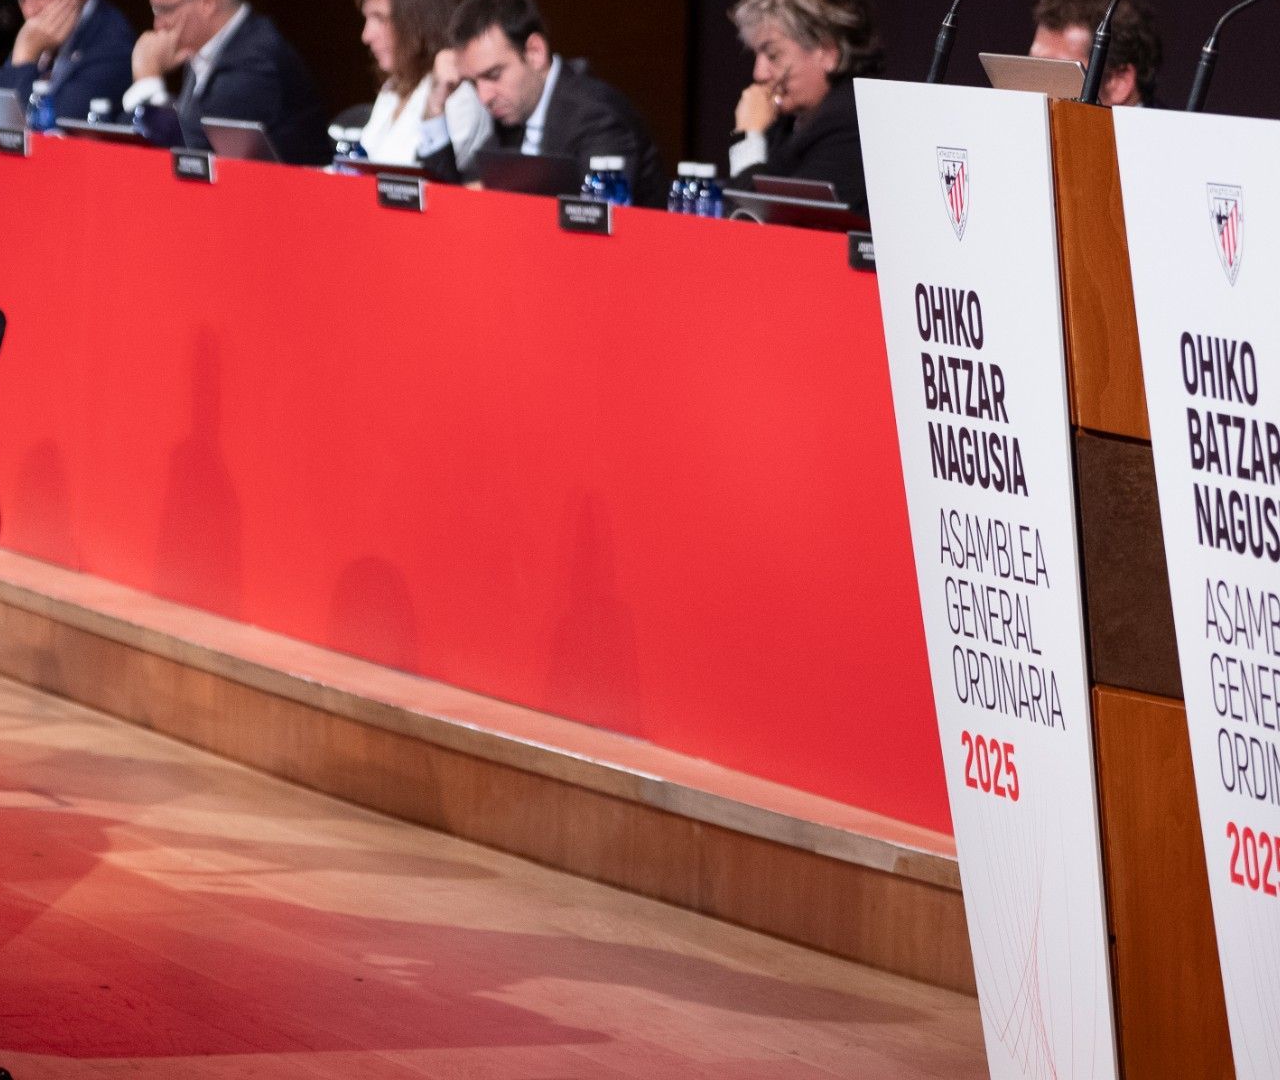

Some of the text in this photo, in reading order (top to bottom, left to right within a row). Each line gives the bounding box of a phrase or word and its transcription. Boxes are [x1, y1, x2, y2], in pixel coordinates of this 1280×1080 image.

[915, 283, 984, 350] OHIKO
[921, 352, 1009, 424] BATZAR
[1180, 332, 1258, 407] OHIKO
[928, 422, 1029, 497] NAGUSIA
[940, 507, 1050, 588] ASAMBLEA
[945, 576, 1042, 655] GENERAL
[953, 645, 1066, 731] ORDINARIA
[961, 730, 1019, 802] 2025
